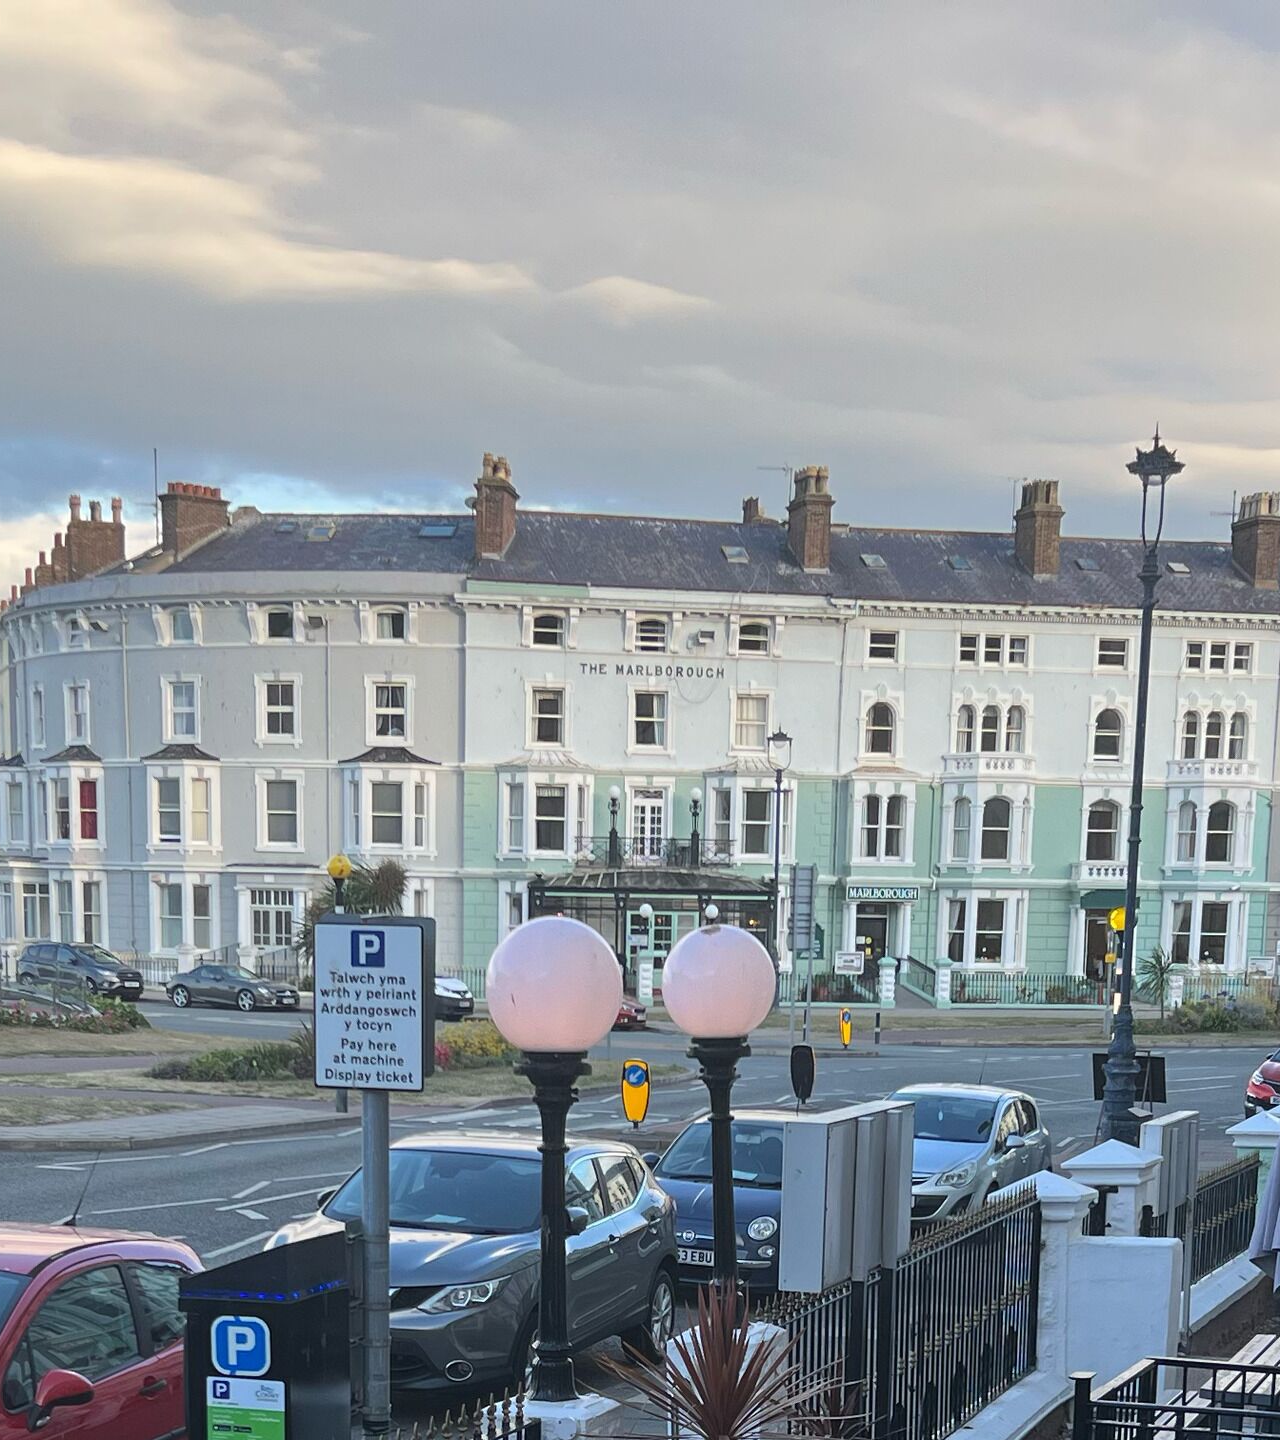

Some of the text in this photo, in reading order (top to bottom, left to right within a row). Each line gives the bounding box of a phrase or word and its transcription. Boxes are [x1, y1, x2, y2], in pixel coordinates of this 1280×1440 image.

[580, 663, 725, 679] THE MARLBOROUGH
[848, 887, 918, 899] MARLBOROUGH
[358, 933, 381, 965] P
[330, 971, 406, 987] Talwch yma
[320, 987, 417, 1001] wrth y peiriant
[321, 1003, 417, 1018] Arddangoswch
[344, 1019, 392, 1032] y tocyn
[340, 1038, 397, 1052] Pay here
[333, 1055, 404, 1067] at machine
[324, 1069, 414, 1083] Display ticket
[691, 1251, 713, 1263] EBU
[227, 1326, 256, 1366] P
[215, 1383, 228, 1398] P
